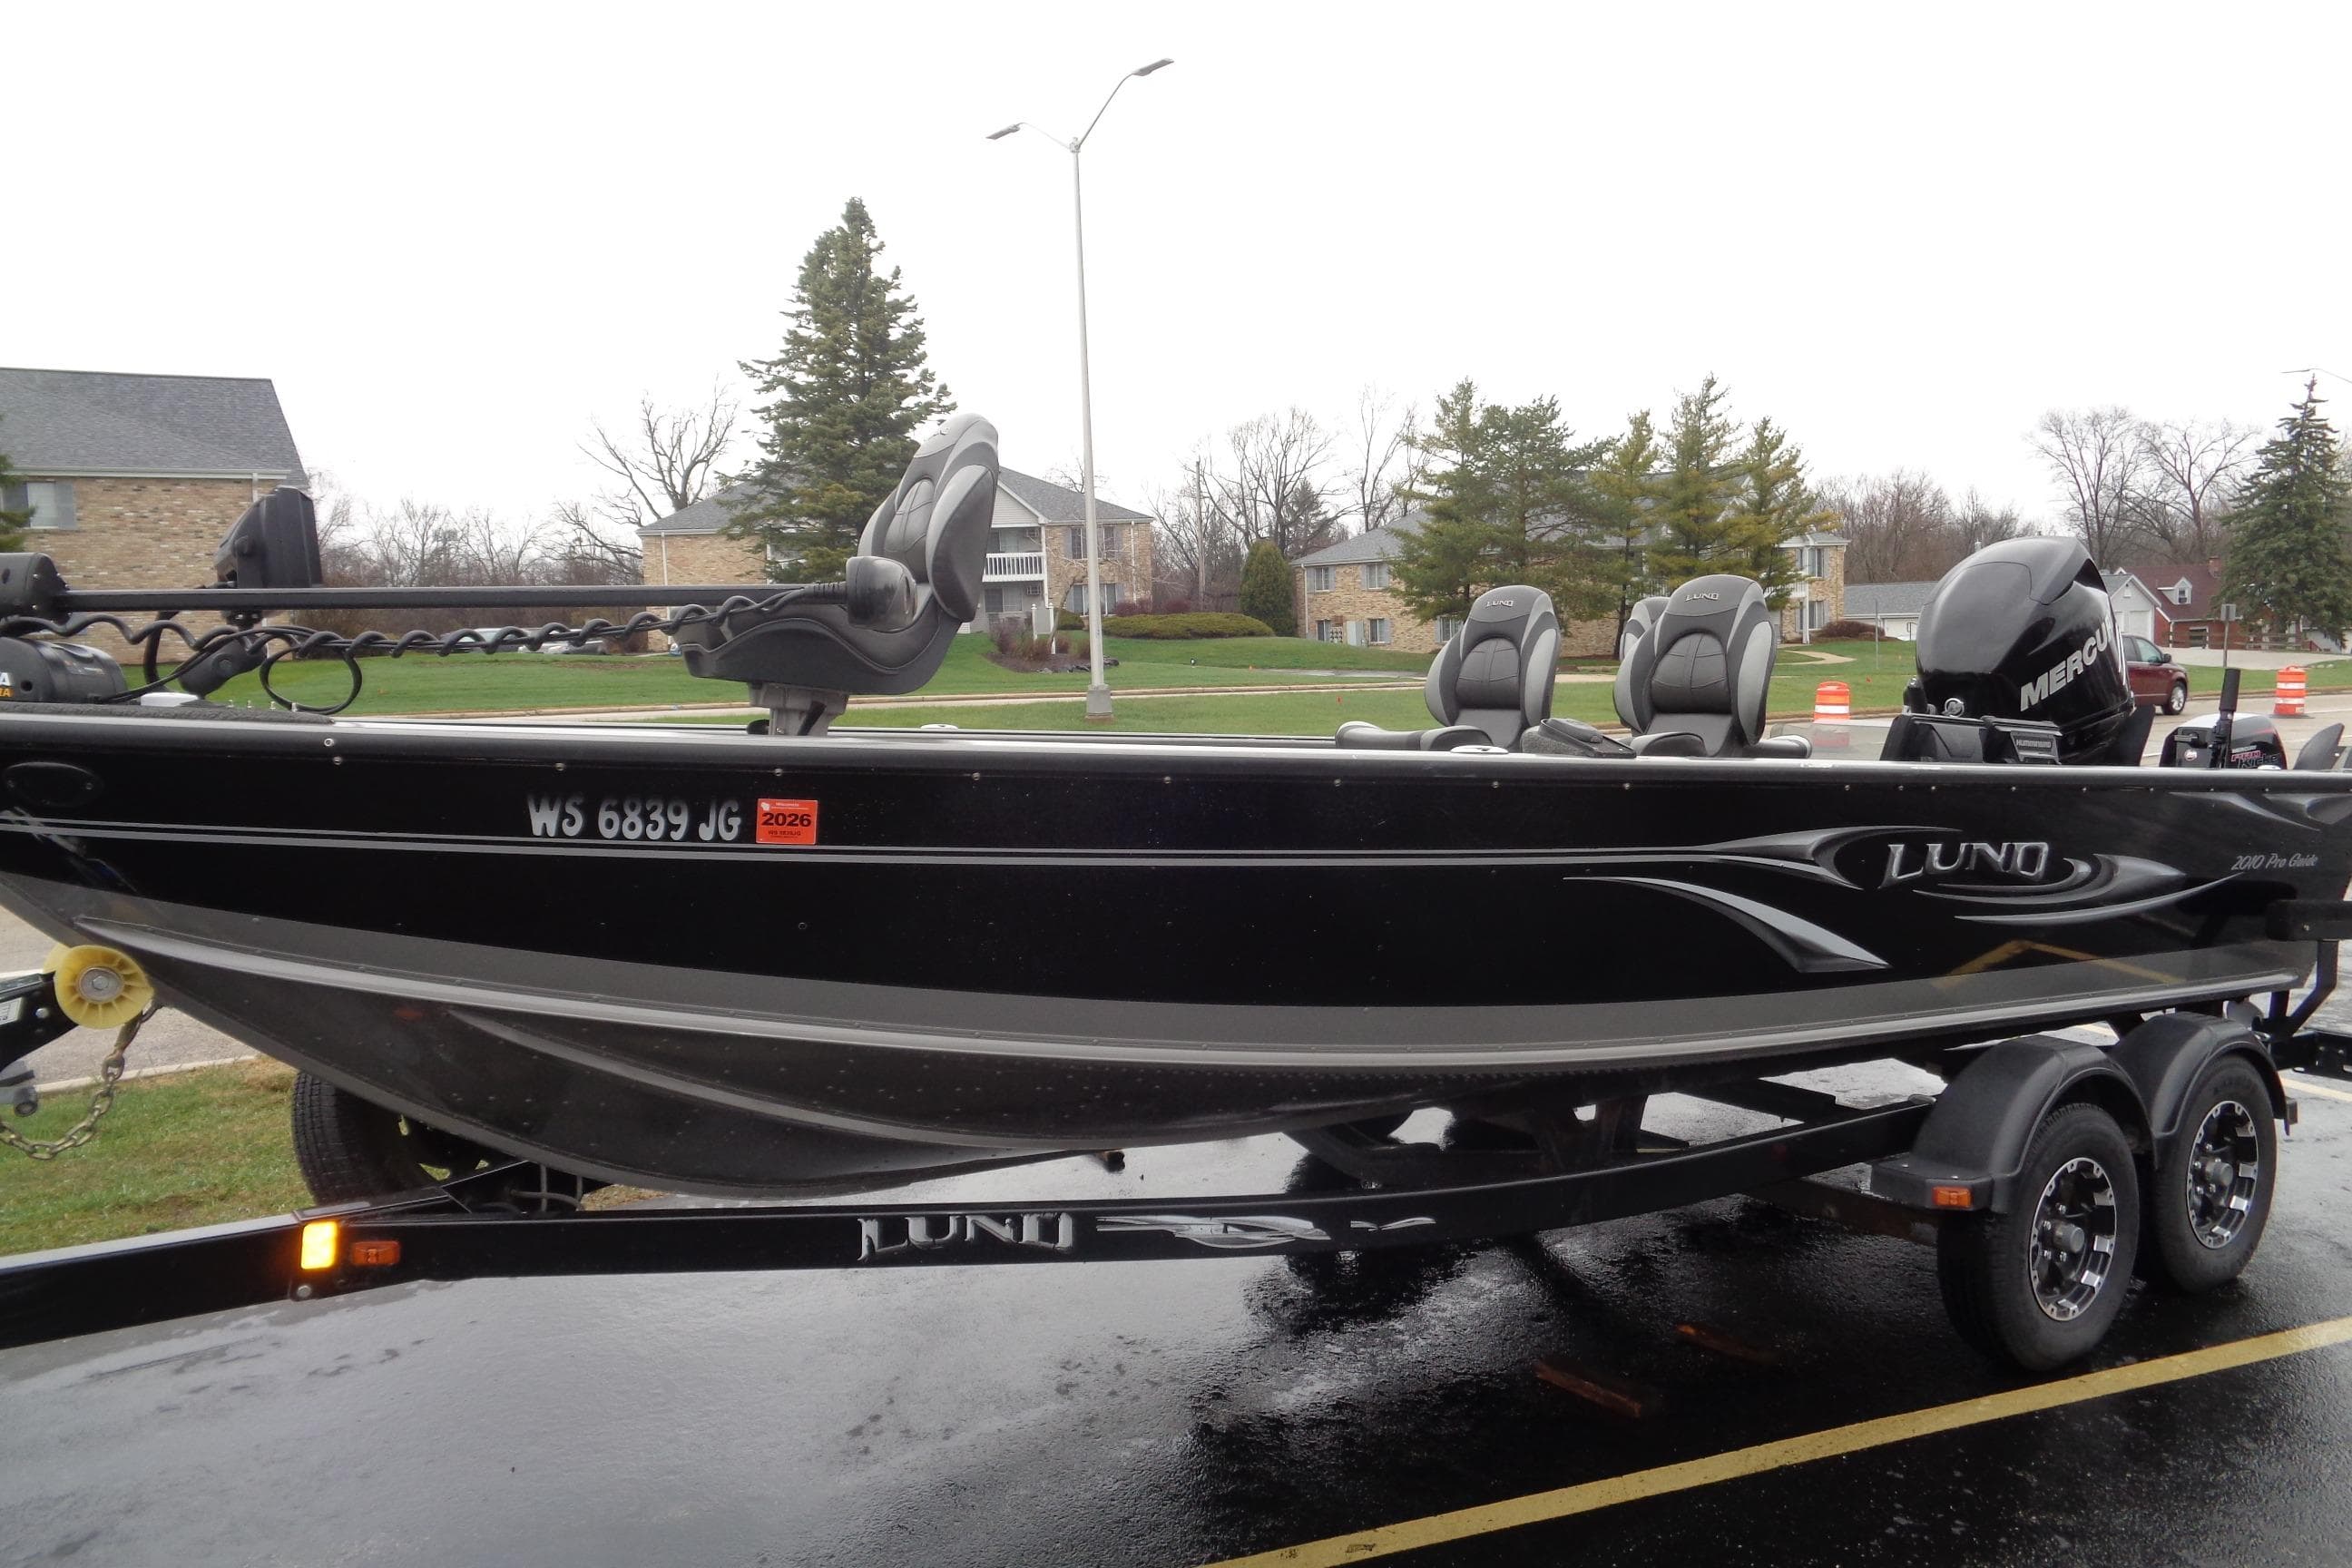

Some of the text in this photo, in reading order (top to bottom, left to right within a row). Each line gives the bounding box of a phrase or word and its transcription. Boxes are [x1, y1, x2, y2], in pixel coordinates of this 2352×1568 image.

[526, 795, 741, 841] WS 6839 JG
[761, 812, 812, 827] 2026
[1877, 842, 2049, 889] LUND
[2231, 855, 2265, 870] 2010
[2265, 853, 2287, 868] Pro
[857, 1211, 1073, 1262] LUND
